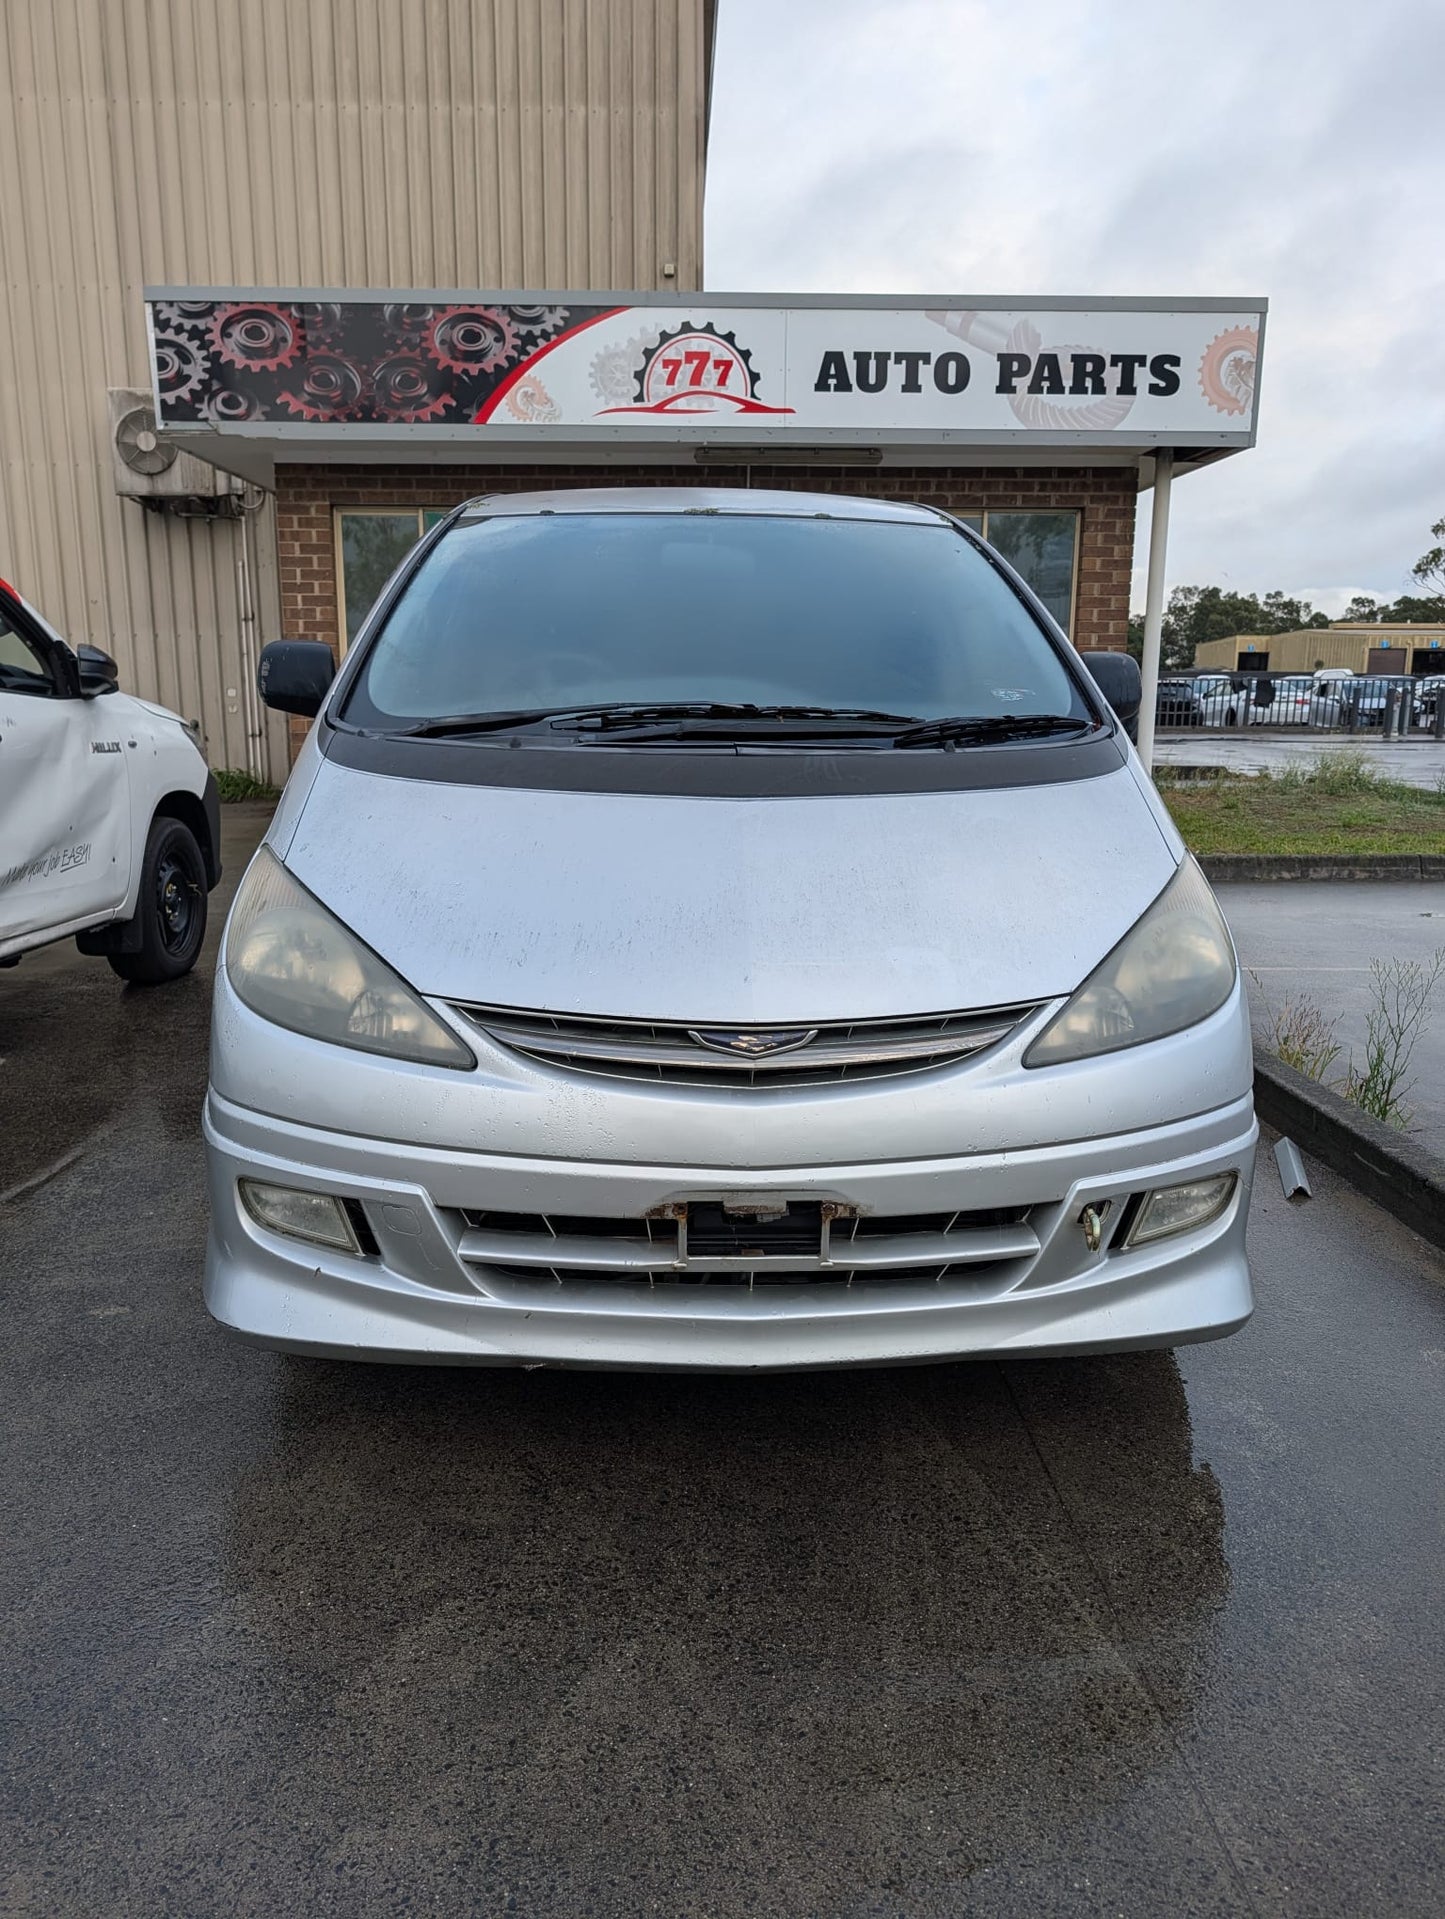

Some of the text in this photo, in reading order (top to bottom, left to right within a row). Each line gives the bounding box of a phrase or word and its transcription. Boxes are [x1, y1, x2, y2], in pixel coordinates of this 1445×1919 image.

[662, 351, 734, 387] 777
[814, 351, 1181, 396] AUTO PARTS
